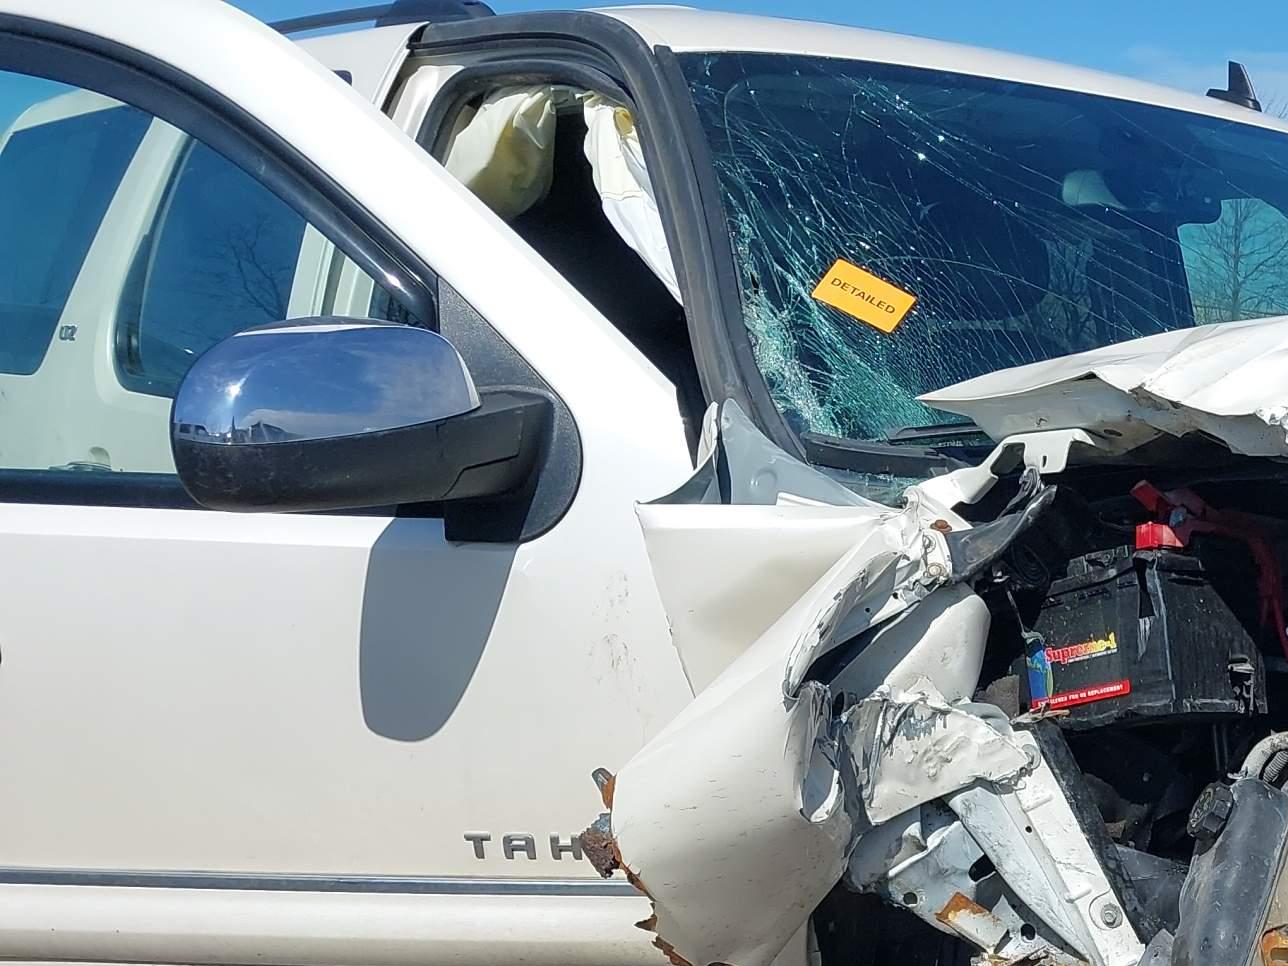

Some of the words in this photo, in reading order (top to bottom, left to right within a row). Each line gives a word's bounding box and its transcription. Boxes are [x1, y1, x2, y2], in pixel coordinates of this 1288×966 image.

[830, 277, 896, 314] DETAILED
[1044, 631, 1117, 665] Supreme-1
[1087, 684, 1123, 697] REPLACEMENT
[463, 831, 584, 861] TAH
